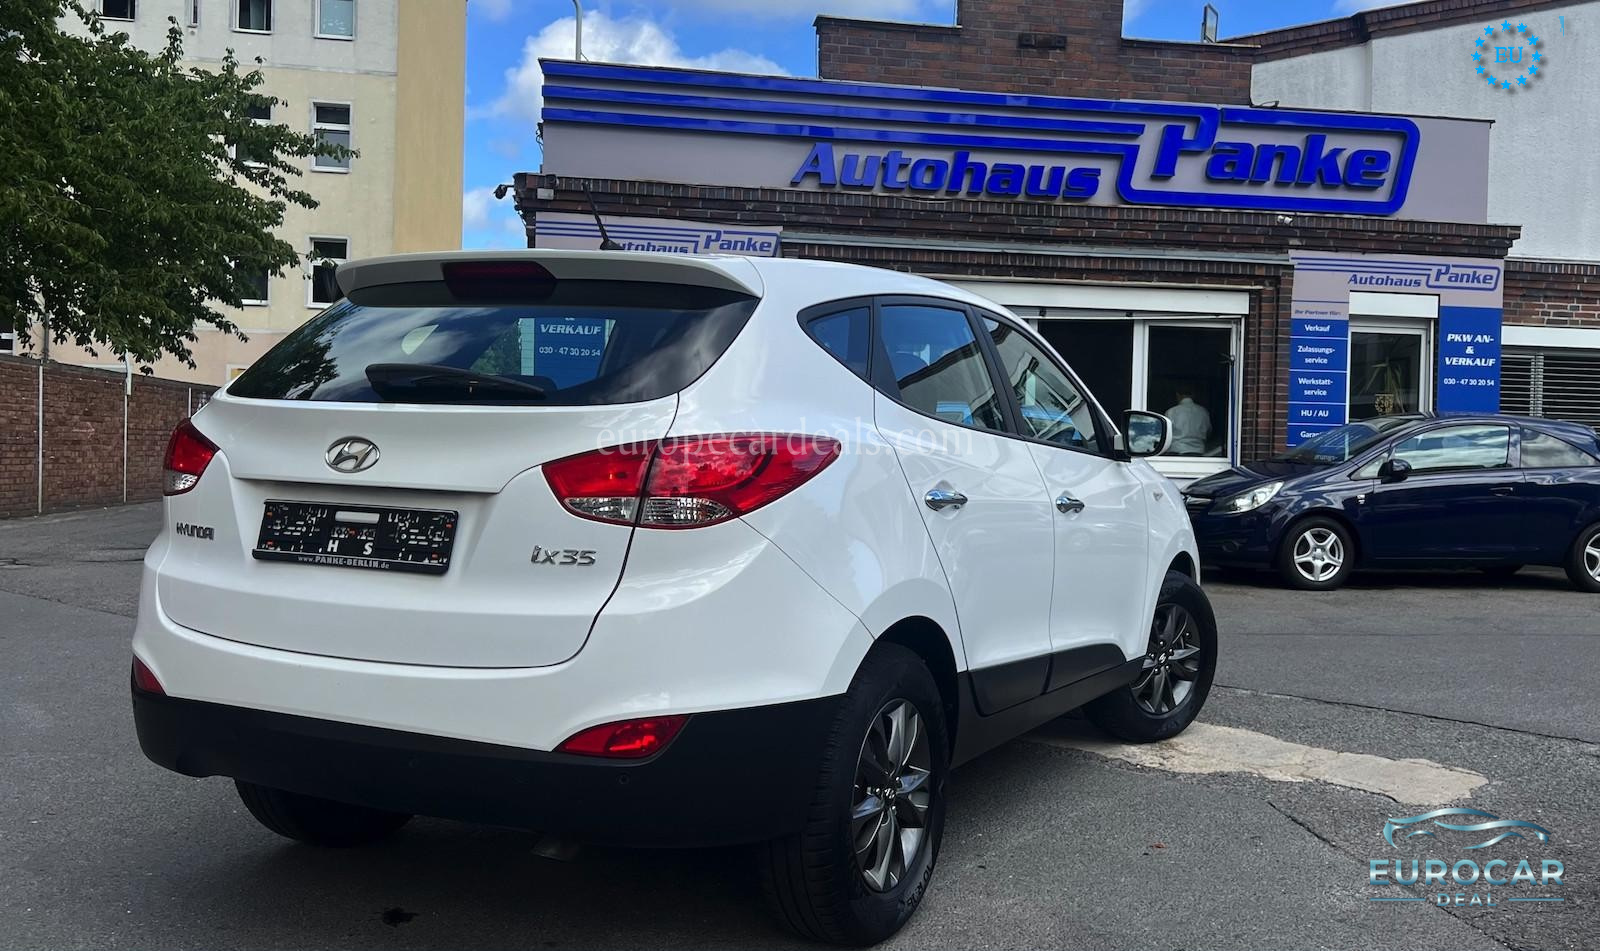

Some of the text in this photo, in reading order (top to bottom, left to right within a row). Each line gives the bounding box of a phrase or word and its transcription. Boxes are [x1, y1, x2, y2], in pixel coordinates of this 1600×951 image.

[792, 108, 1393, 202] Autohaus Panke
[704, 230, 772, 252] Panke
[1348, 264, 1494, 287] Autohaus Panke
[540, 324, 602, 335] VERKAUF
[1304, 324, 1331, 332] Verkauf
[1447, 334, 1494, 343] PKW AN-
[539, 346, 553, 354] 030
[559, 347, 568, 355] 47
[569, 348, 579, 356] 30
[580, 348, 590, 356] 20
[591, 348, 601, 356] 54
[1297, 345, 1336, 354] Zulassungs-
[1465, 346, 1474, 355] &
[1304, 356, 1328, 364] service
[1445, 357, 1496, 367] VERKAUF
[1298, 377, 1334, 386] Werkstatt-
[1460, 378, 1468, 386] 47
[1469, 378, 1477, 386] 30
[1486, 379, 1494, 387] 54
[1301, 409, 1312, 417] HU
[176, 522, 215, 541] HYUNDAI
[327, 539, 374, 555] H S
[530, 545, 597, 566] ix35
[298, 555, 390, 569] www.PANKE-BERLIN.de
